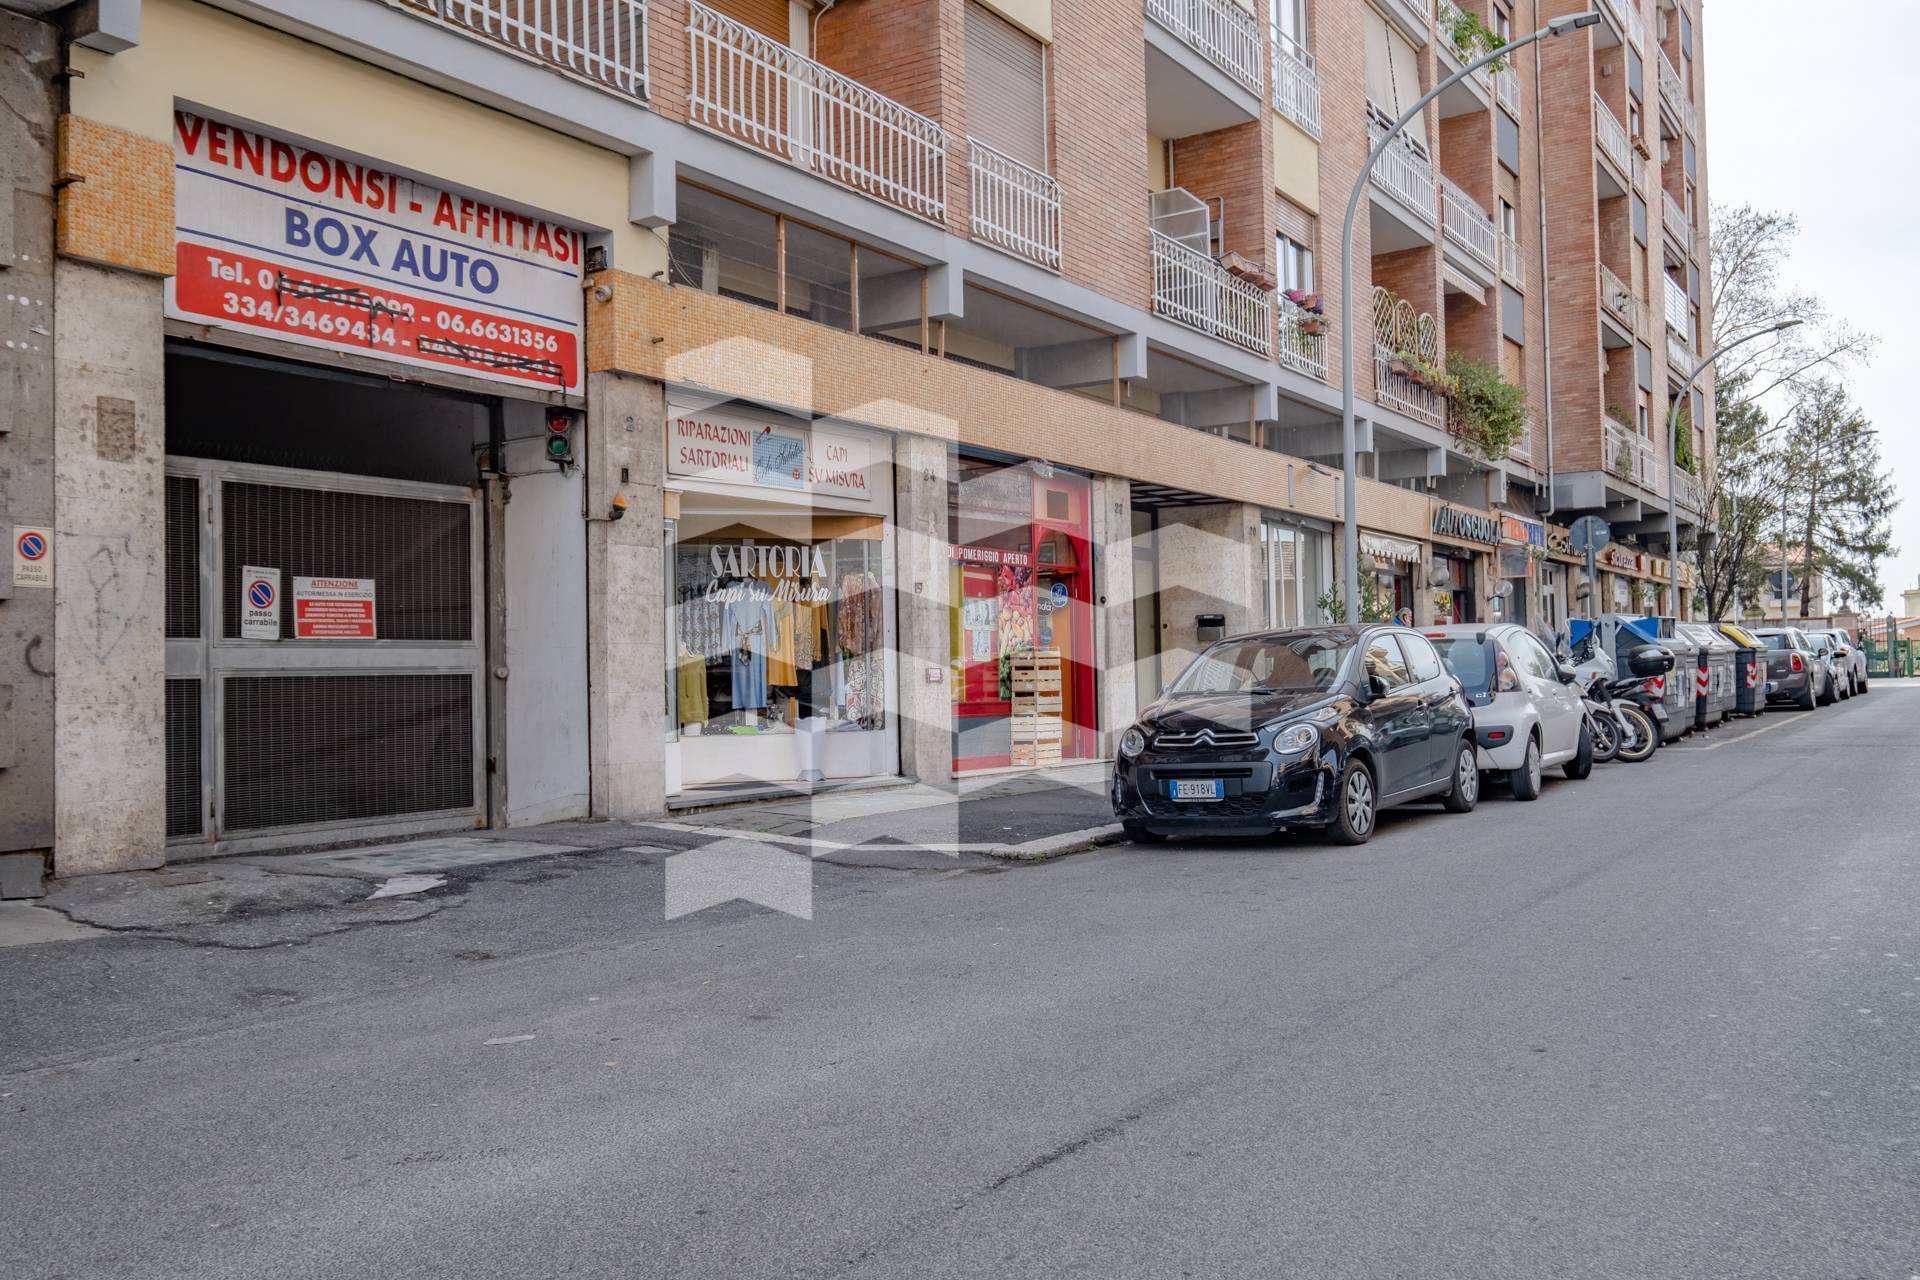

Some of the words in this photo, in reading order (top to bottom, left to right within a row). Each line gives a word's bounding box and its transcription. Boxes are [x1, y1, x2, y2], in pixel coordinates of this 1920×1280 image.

[175, 111, 397, 213] VENDONSI
[433, 192, 579, 265] AFFITTASI
[285, 208, 380, 266] BOX
[392, 238, 499, 294] AUTO
[207, 257, 250, 287] Tel.
[437, 310, 558, 353] 06.6631356
[223, 292, 396, 347] 334/3469434
[677, 419, 751, 447] RIPARAZIONI
[680, 446, 748, 472] SARTORIALI
[826, 445, 848, 462] CAPI
[825, 468, 866, 489] MISURA
[1435, 507, 1502, 544] AUTOSCUOLA
[22, 565, 42, 573] PASSO
[710, 544, 827, 578] SARTORIA
[958, 548, 999, 564] POMERIGGIO
[1003, 553, 1028, 566] APERTO
[16, 574, 48, 582] CARRABILE
[311, 579, 359, 588] ATTENZIONE
[705, 579, 745, 610] Capi
[769, 578, 831, 602] Misura
[244, 618, 278, 626] carrabile
